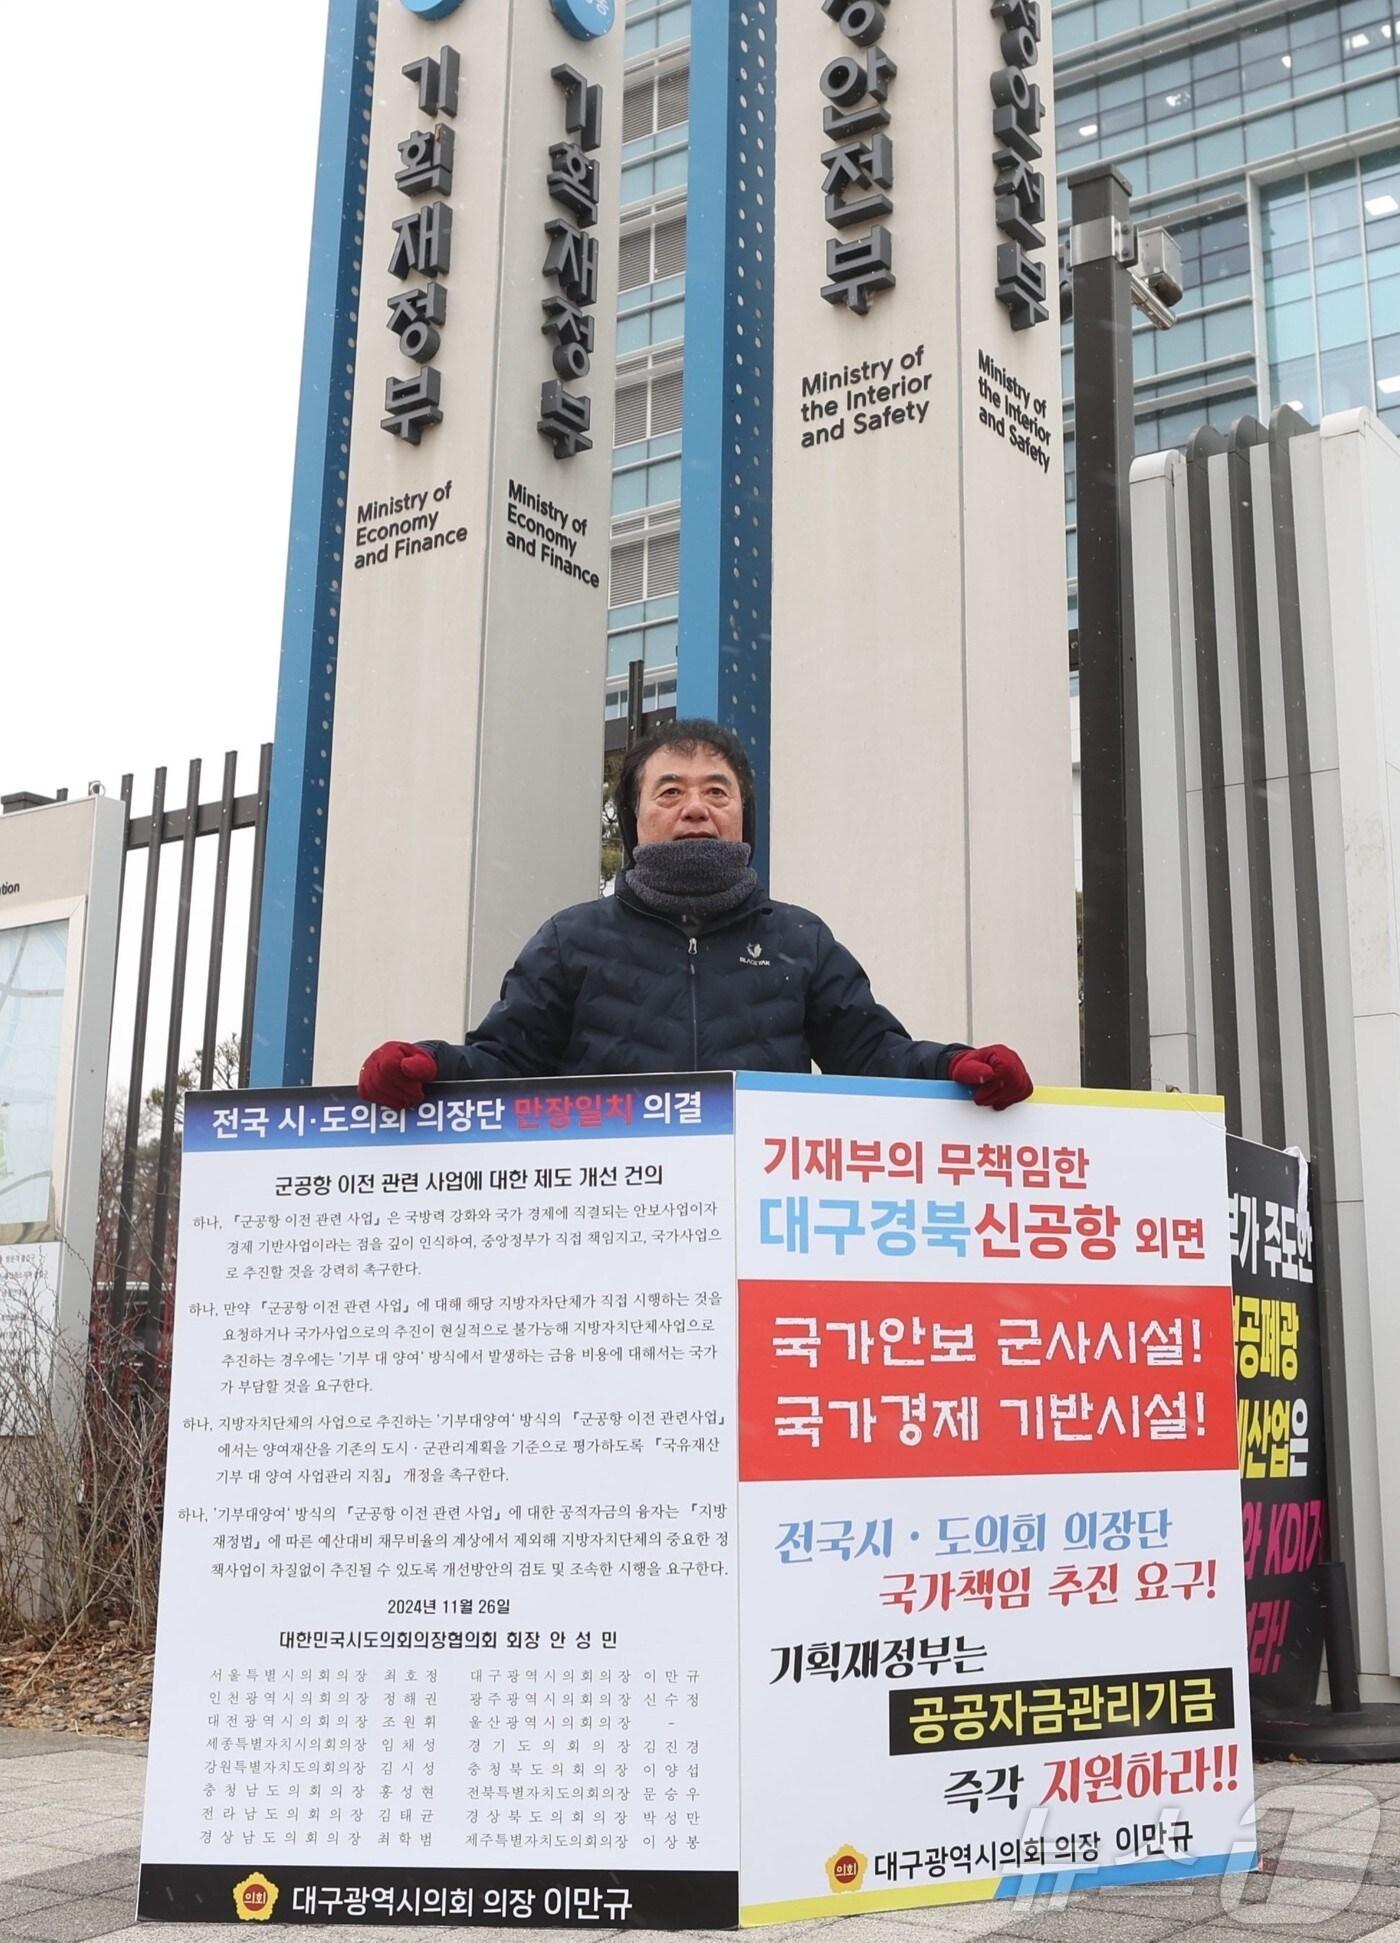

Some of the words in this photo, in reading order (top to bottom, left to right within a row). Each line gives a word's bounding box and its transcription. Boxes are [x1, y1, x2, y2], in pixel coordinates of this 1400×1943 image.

[381, 45, 460, 445] 기획재정부
[537, 63, 603, 460] 기획재정부
[801, 357, 893, 397] Ministry
[900, 344, 924, 370] of
[978, 349, 1030, 407] Ministry
[1033, 398, 1046, 418] of
[801, 399, 838, 422] the
[847, 373, 932, 411] Interior
[978, 376, 1000, 408] the
[1005, 395, 1051, 446] Interior
[801, 418, 844, 448] and
[853, 400, 930, 434] Safety
[979, 406, 1005, 438] and
[1009, 424, 1050, 474] Safety
[357, 491, 428, 524] Ministry
[433, 480, 452, 501] of
[508, 479, 568, 530] Ministry
[572, 518, 587, 536] of
[354, 543, 388, 569] and
[394, 526, 468, 559] Finance
[356, 510, 439, 546] Economy
[507, 502, 577, 558] Economy
[506, 529, 536, 557] and
[541, 543, 600, 588] Finance
[0, 881, 20, 896] tion
[212, 1107, 269, 1139] 전국
[416, 1098, 505, 1133] 의장단
[514, 1093, 633, 1131] 만장일치
[643, 1091, 702, 1125] 의결
[275, 1175, 332, 1196] 군공항
[338, 1174, 374, 1195] 이전
[381, 1172, 418, 1193] 관련
[424, 1170, 482, 1192] 사업에
[490, 1169, 528, 1190] 대한
[533, 1168, 572, 1189] 제도
[579, 1166, 617, 1187] 개선
[624, 1165, 662, 1186] 건의
[764, 1136, 924, 1185] 기재부의
[937, 1141, 1090, 1189] 무책임한
[194, 1216, 222, 1230] 하나,
[285, 1213, 310, 1228] 이전
[316, 1212, 343, 1227] 관련
[404, 1209, 444, 1224] 국방력
[450, 1208, 492, 1224] 강화와
[495, 1207, 524, 1222] 국가
[528, 1205, 568, 1221] 경제에
[574, 1204, 629, 1220] 직결되는
[634, 1201, 717, 1218] 안보사업이자
[760, 1196, 1121, 1260] 대구경북신공항
[1135, 1217, 1206, 1259] 외면
[228, 1240, 252, 1255] 경제
[258, 1238, 352, 1254] 기반사업이라는
[357, 1235, 384, 1251] 점을
[388, 1236, 413, 1251] 깊이
[419, 1232, 476, 1250] 인식하여,
[481, 1232, 551, 1248] 중앙정부가
[556, 1231, 581, 1246] 직접
[588, 1230, 646, 1245] 책임지고,
[651, 1228, 722, 1244] 국가사업으
[226, 1267, 238, 1278] 로
[243, 1264, 284, 1280] 추진할
[288, 1264, 315, 1279] 것을
[319, 1263, 358, 1278] 강력히
[363, 1261, 421, 1277] 촉구한다.
[223, 1327, 291, 1342] 요청하거나
[294, 1324, 389, 1341] 국가사업으로의
[393, 1323, 434, 1339] 추진이
[440, 1320, 509, 1338] 현실적으로
[512, 1321, 568, 1336] 불가능해
[574, 1318, 715, 1336] 지방자치단체사업으로
[772, 1316, 977, 1369] 국가안보
[997, 1317, 1202, 1367] 군사시설!
[221, 1380, 234, 1394] 가
[238, 1378, 279, 1394] 부담할
[284, 1378, 310, 1393] 것을
[314, 1378, 372, 1393] 요구한다.
[183, 1417, 212, 1431] 하나,
[219, 1415, 312, 1432] 지방자치단체의
[317, 1415, 372, 1430] 사업으로
[376, 1414, 432, 1430] 추진하는
[520, 1412, 560, 1428] 방식의
[628, 1411, 655, 1426] 이전
[774, 1393, 979, 1448] 국가경제
[999, 1391, 1206, 1443] 기반시설!
[216, 1469, 243, 1484] 기부
[248, 1469, 260, 1484] 대
[266, 1469, 292, 1484] 양여
[297, 1468, 351, 1484] 사업관리
[403, 1468, 445, 1483] 개정을
[448, 1464, 508, 1482] 촉구한다.
[774, 1518, 893, 1565] 전국시
[935, 1511, 1046, 1556] 도의회
[1063, 1508, 1173, 1552] 의장단
[211, 1560, 265, 1578] 책사업이
[270, 1560, 325, 1578] 차질없이
[330, 1560, 371, 1578] 추진될
[377, 1562, 391, 1578] 수
[396, 1560, 438, 1577] 있도록
[443, 1560, 512, 1577] 개선방안의
[519, 1561, 546, 1576] 검토
[552, 1561, 564, 1577] 및
[570, 1561, 613, 1576] 조속한
[618, 1560, 661, 1577] 시행을
[666, 1561, 728, 1576] 요구한다.
[879, 1566, 1030, 1615] 국가책임
[1048, 1563, 1119, 1608] 추진
[1135, 1559, 1217, 1602] 요구!
[387, 1599, 437, 1615] 2024년
[443, 1599, 473, 1615] 11월
[478, 1598, 511, 1615] 26일
[280, 1630, 497, 1650] 대한민국시도의회의장협의회
[506, 1630, 540, 1650] 회장
[769, 1636, 987, 1686] 기획재정부는
[1247, 1599, 1291, 1676] 라!
[909, 1677, 1217, 1745] 공공자금관리기금
[944, 1764, 1024, 1815] 즉각
[1040, 1744, 1239, 1806] 지원하라!!
[835, 1863, 857, 1877] 의회
[875, 1837, 1046, 1882] 대구광역시의회
[1055, 1832, 1101, 1862] 의장
[1115, 1821, 1194, 1857] 이만규
[244, 1892, 266, 1905] 의회
[292, 1885, 473, 1918] 대구광역시의회
[482, 1888, 536, 1919] 의장
[543, 1886, 633, 1920] 이만규
